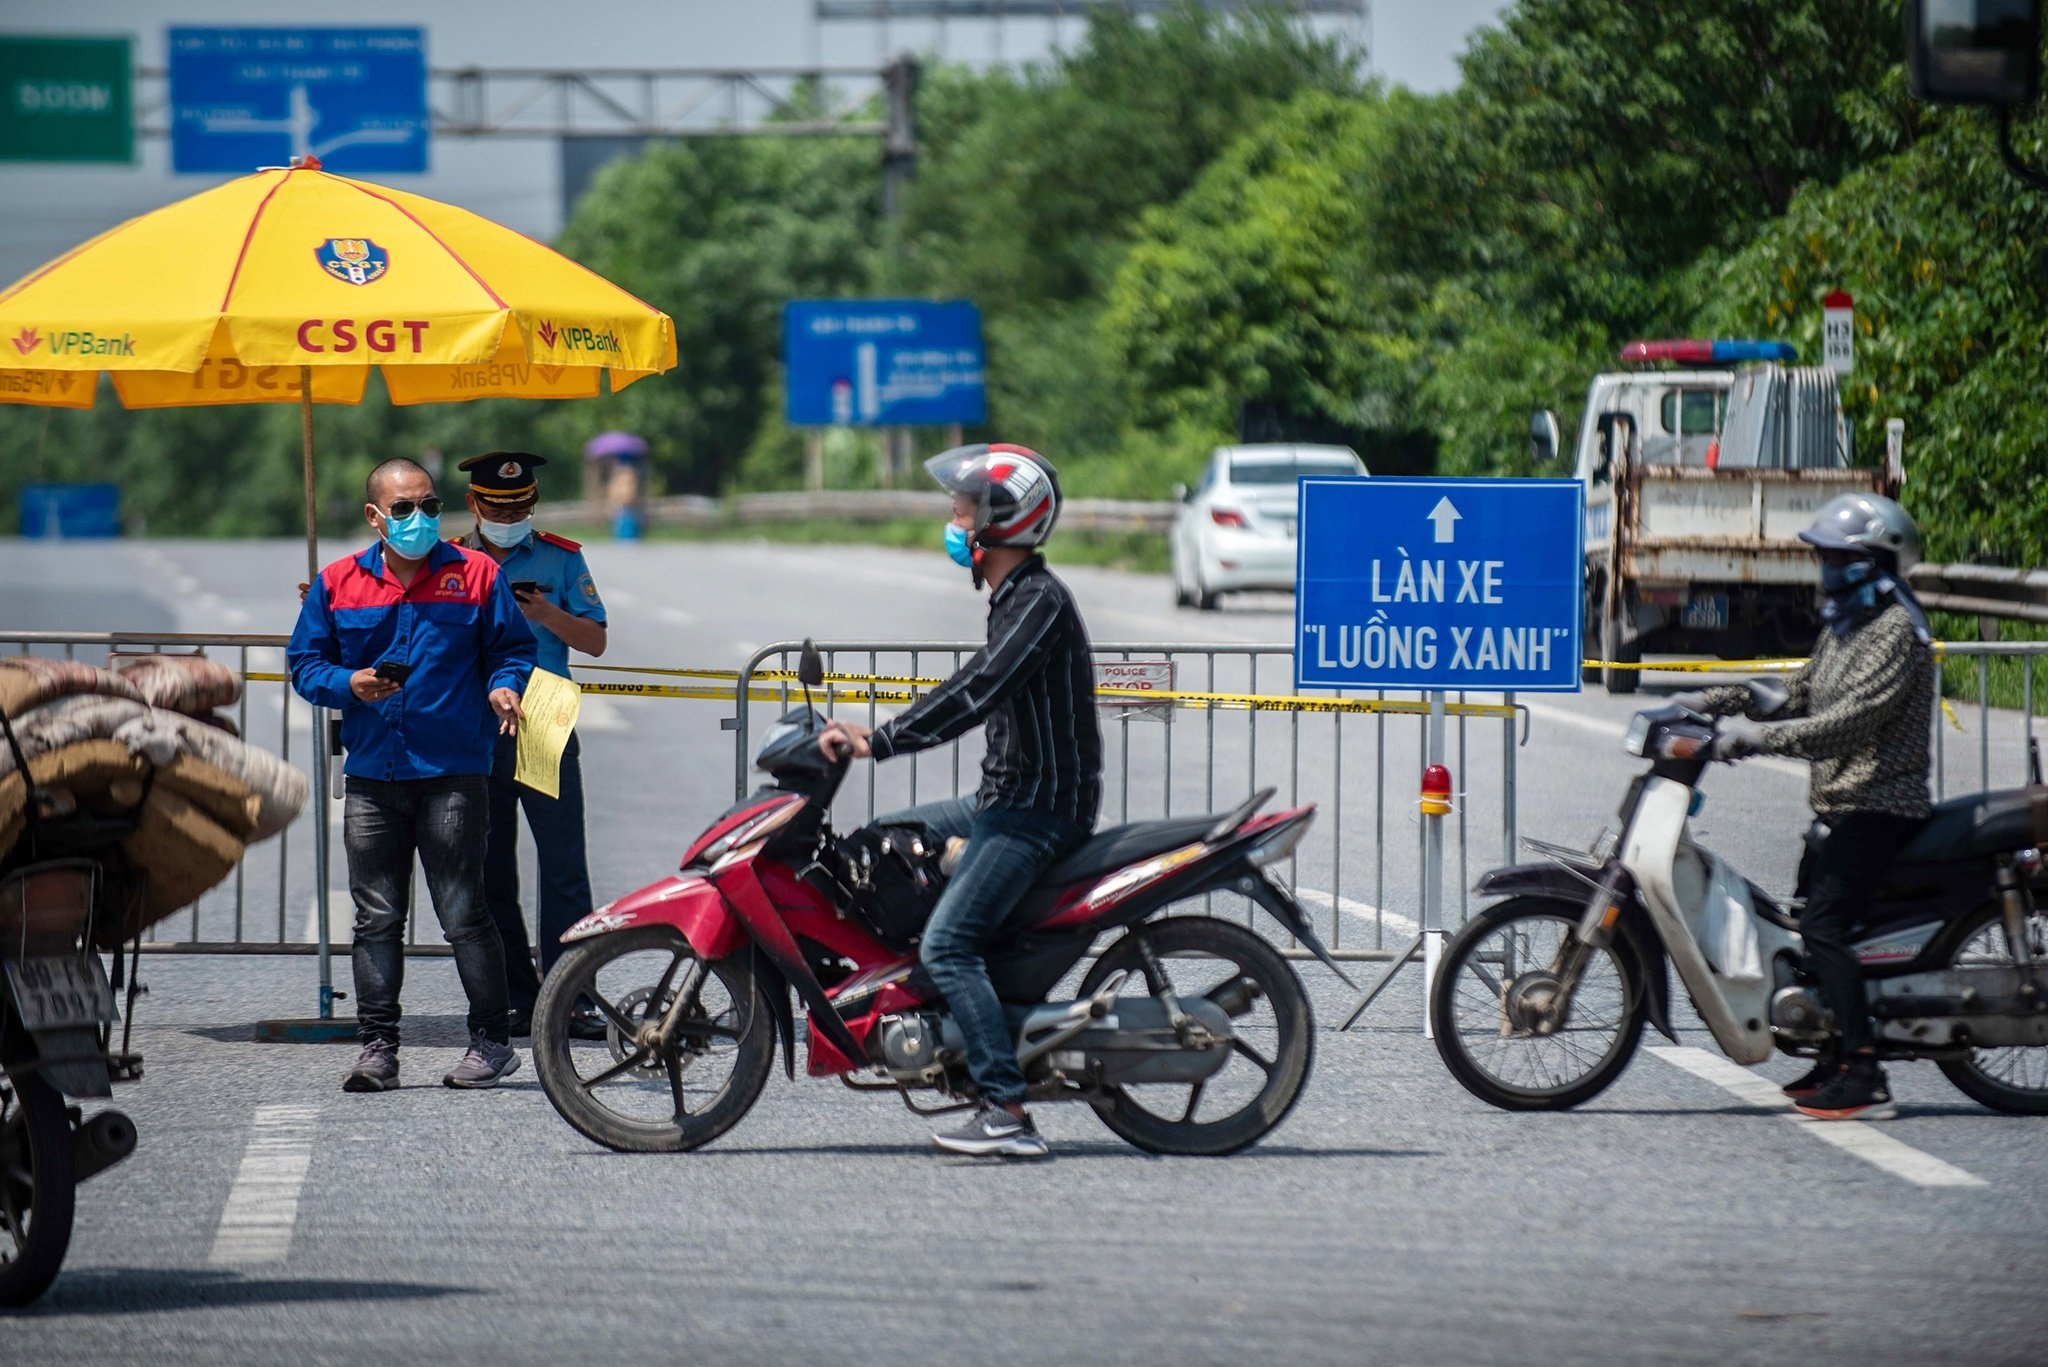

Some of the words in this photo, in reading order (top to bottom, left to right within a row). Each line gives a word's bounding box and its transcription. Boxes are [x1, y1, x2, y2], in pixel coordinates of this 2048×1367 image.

[49, 332, 136, 356] VPBank
[297, 319, 430, 353] CSGT
[560, 327, 621, 353] VPBank
[1372, 546, 1445, 603] LÀN
[1456, 560, 1504, 604] XE
[1105, 667, 1146, 676] POLICE
